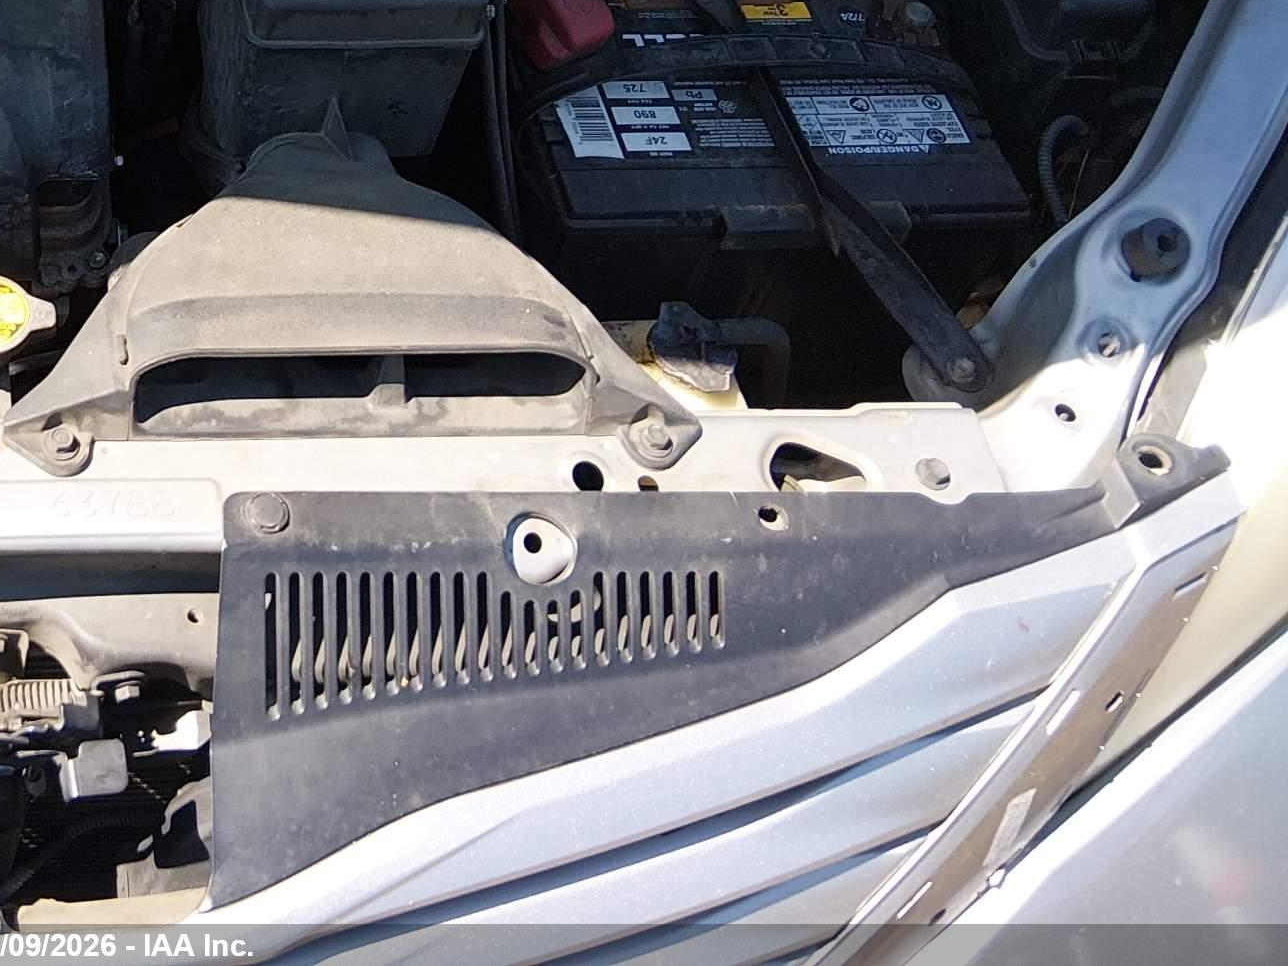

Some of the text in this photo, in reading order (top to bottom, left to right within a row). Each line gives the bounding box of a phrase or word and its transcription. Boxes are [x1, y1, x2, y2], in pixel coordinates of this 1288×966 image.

[622, 84, 647, 93] 725
[685, 91, 703, 99] Pb
[633, 110, 657, 119] 890
[644, 136, 668, 145] 24F
